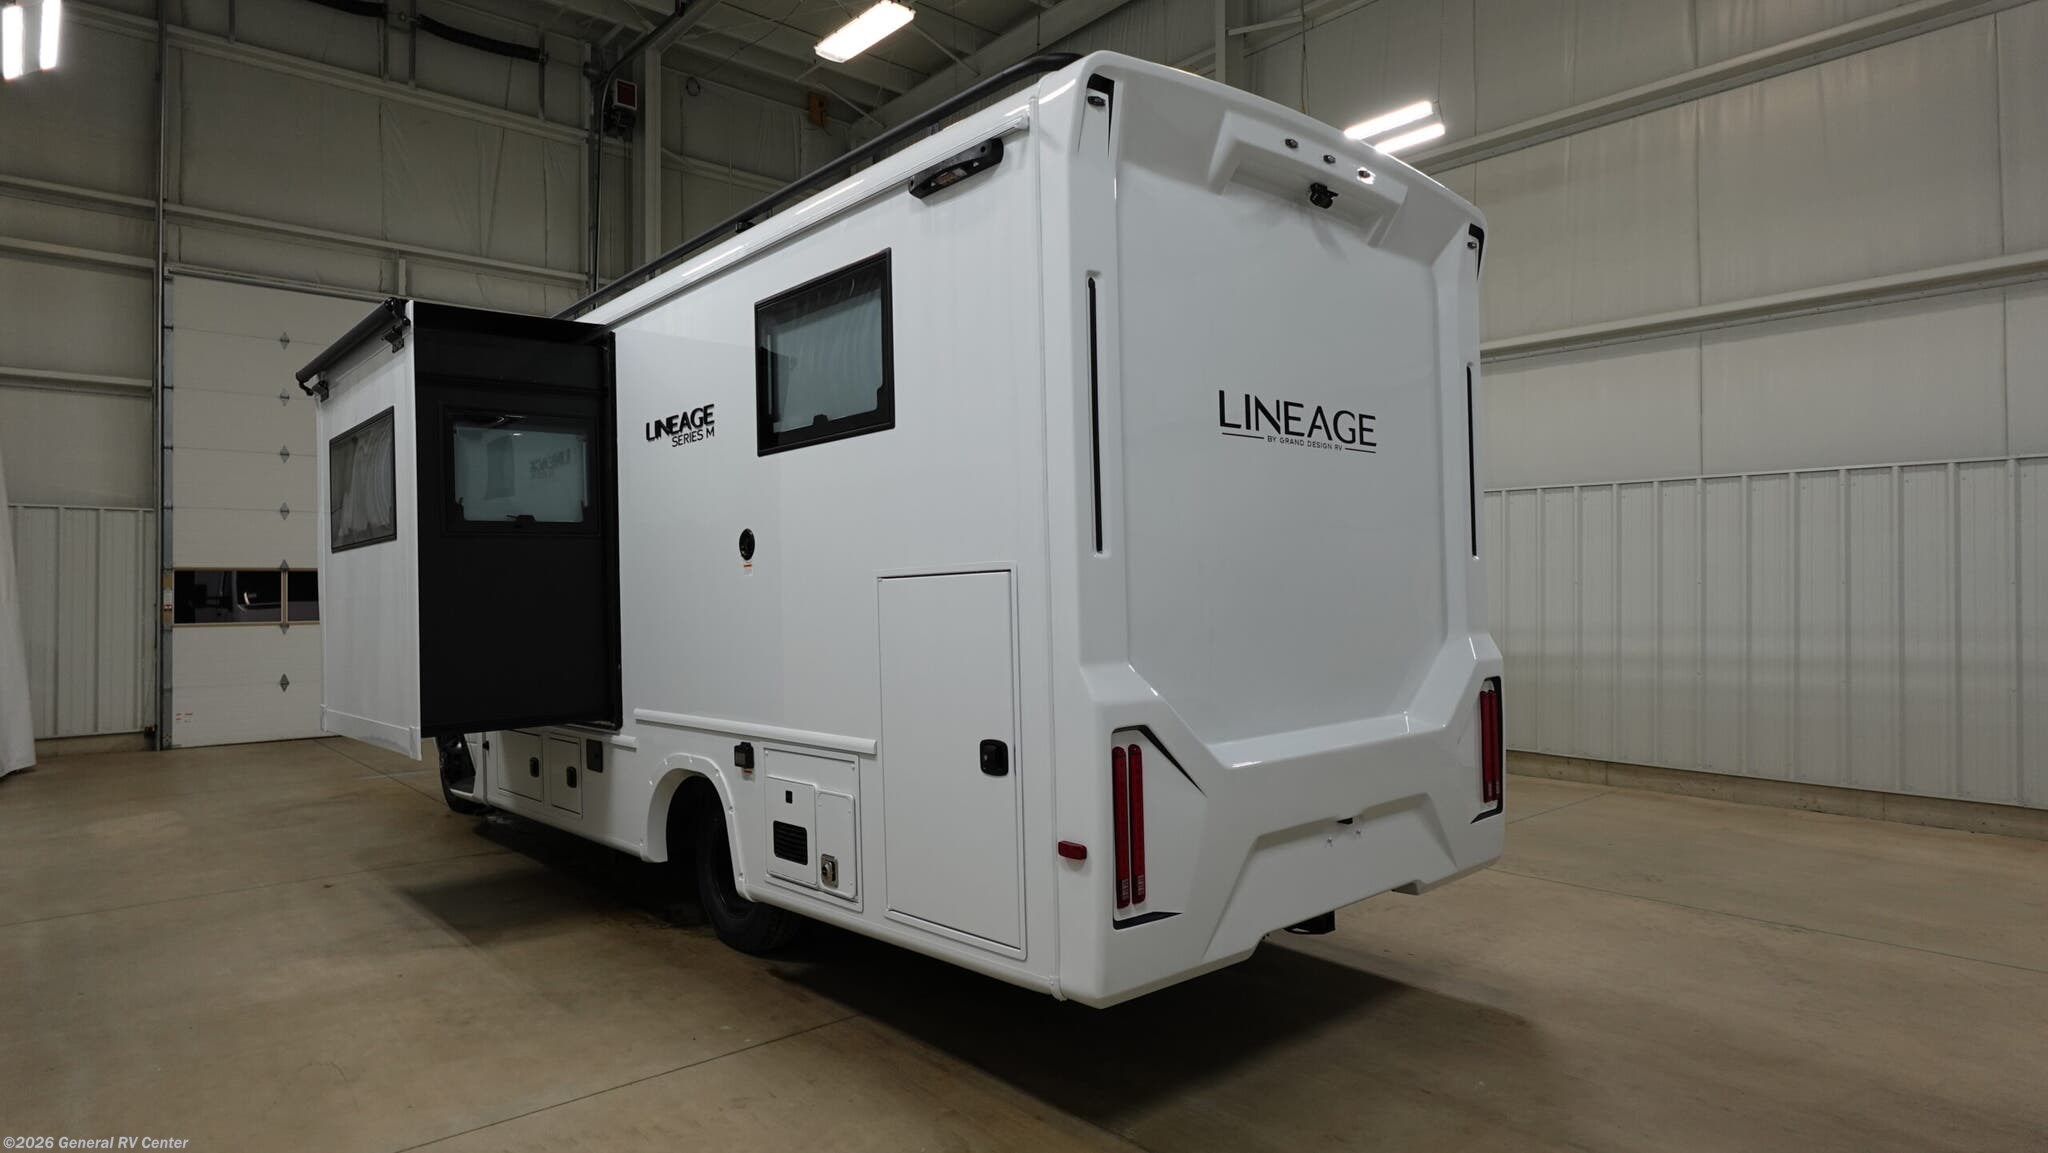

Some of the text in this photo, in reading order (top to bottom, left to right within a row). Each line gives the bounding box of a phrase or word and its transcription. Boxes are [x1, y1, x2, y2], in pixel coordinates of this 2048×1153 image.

[646, 404, 715, 441] LINEAGE
[1219, 390, 1377, 447] LINEAGE
[672, 426, 715, 447] SERIES M
[1280, 437, 1304, 446] GRAND
[1307, 441, 1332, 449] DESIGN
